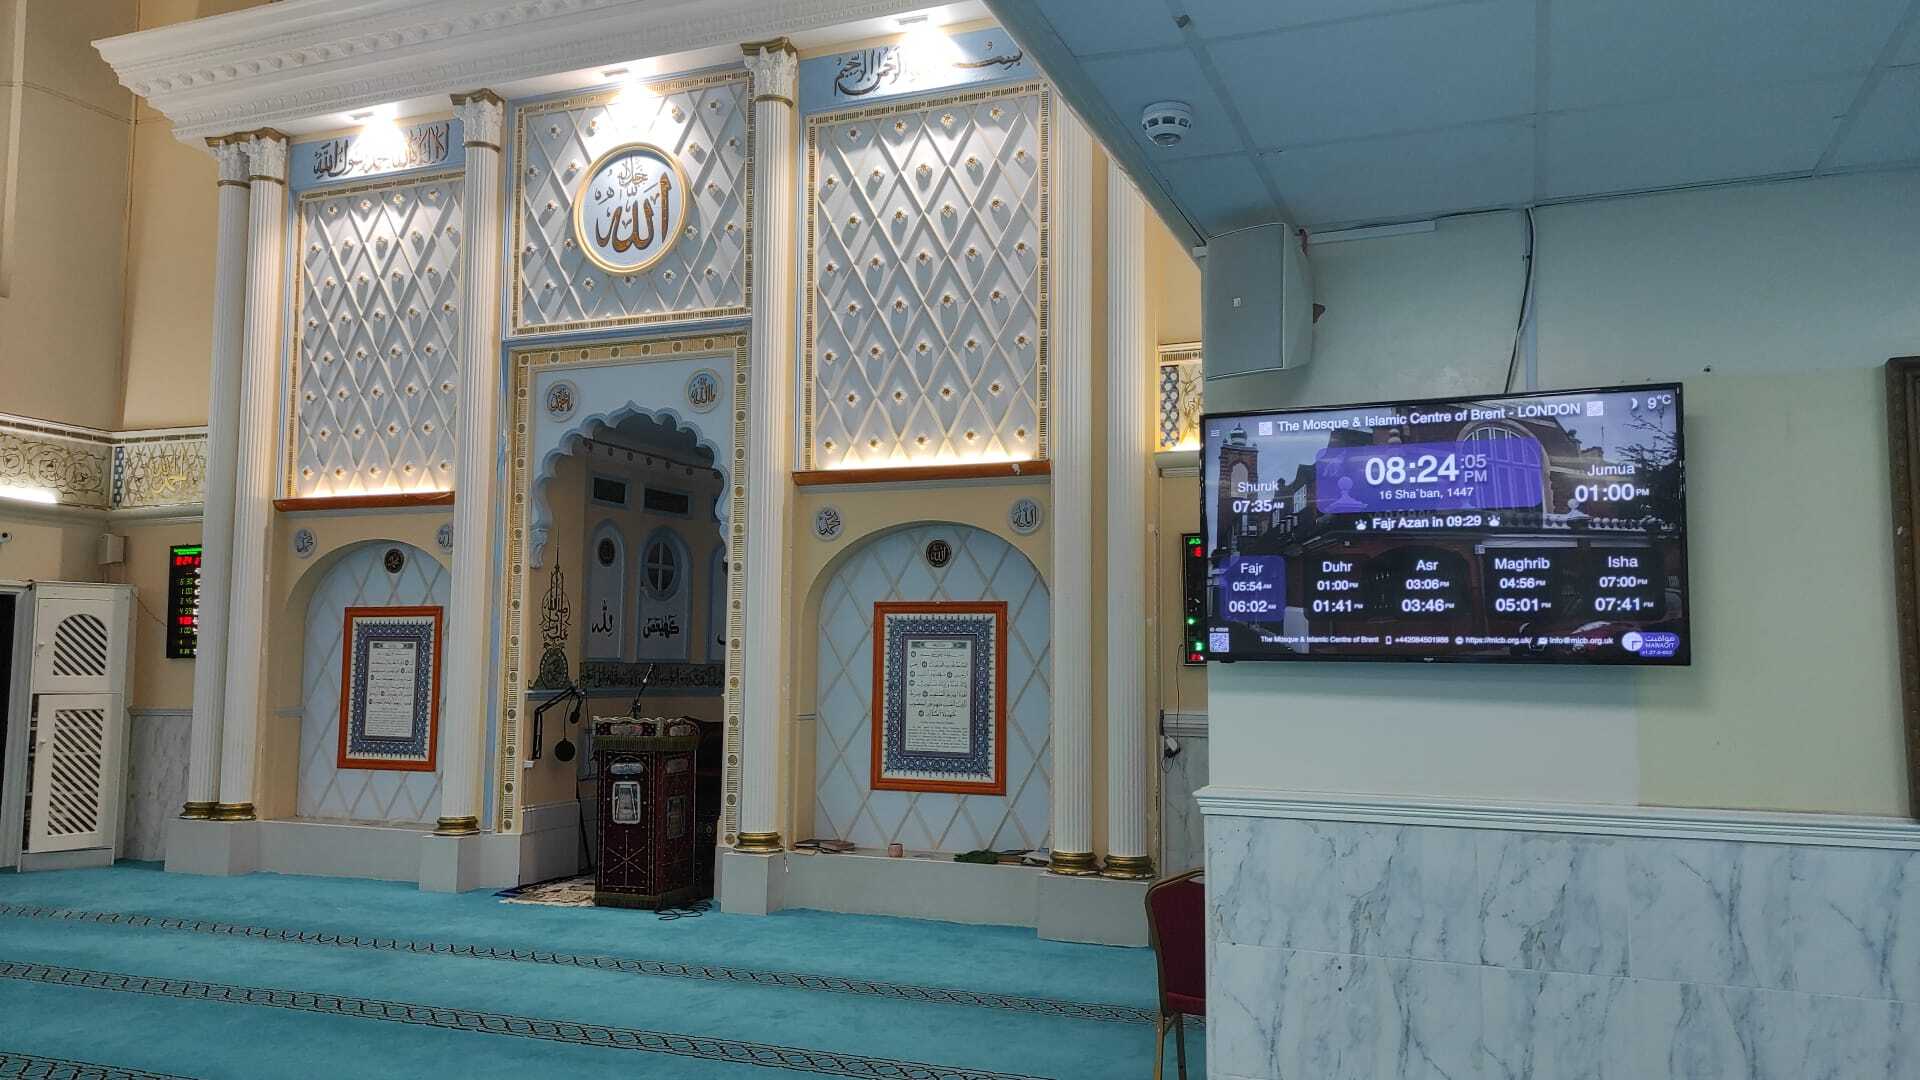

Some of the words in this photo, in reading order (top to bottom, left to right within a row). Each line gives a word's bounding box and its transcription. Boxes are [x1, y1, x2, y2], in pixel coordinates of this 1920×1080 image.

[595, 171, 672, 253] الله
[1647, 394, 1672, 410] 9°C
[1277, 420, 1300, 432] The
[1302, 417, 1350, 432] Mosque
[1352, 416, 1361, 428] &
[1364, 413, 1407, 427] Islamic
[1410, 411, 1452, 424] Centre
[1456, 409, 1470, 421] of
[1470, 406, 1506, 420] Brent
[1518, 403, 1581, 418] LONDON
[1365, 453, 1460, 486] 08:24
[1464, 470, 1488, 483] PM
[1238, 480, 1279, 493] Shuruk
[1380, 490, 1392, 500] 16
[1447, 487, 1474, 497] 1447
[1372, 518, 1397, 531] Fajr
[1398, 517, 1429, 529] Azan
[1432, 516, 1443, 527] in
[1446, 515, 1482, 527] 09:29
[1322, 561, 1353, 573] Duhr
[1416, 559, 1438, 572] Asr
[1494, 557, 1550, 572] Maghrib
[1608, 555, 1639, 568] Isha
[1240, 562, 1265, 577] Fajr
[1260, 635, 1273, 643] The
